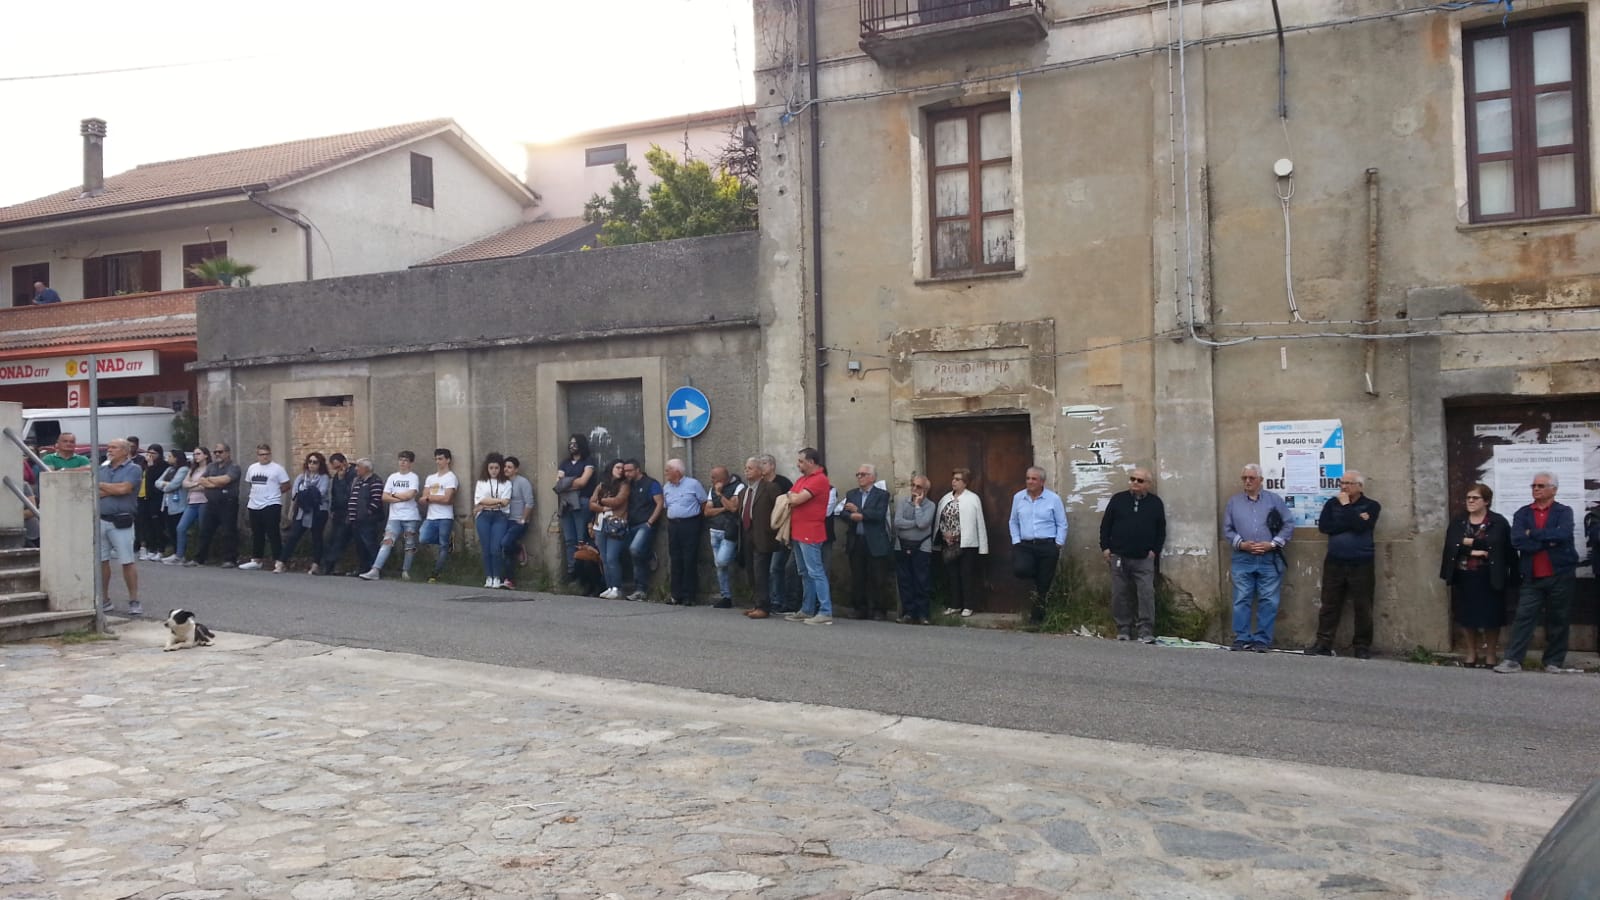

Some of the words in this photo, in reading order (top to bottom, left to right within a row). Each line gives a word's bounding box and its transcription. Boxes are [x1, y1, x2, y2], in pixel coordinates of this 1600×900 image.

[79, 357, 125, 374] CNAD
[126, 361, 144, 371] CITY
[34, 367, 50, 377] CITY
[392, 480, 410, 488] VANS
